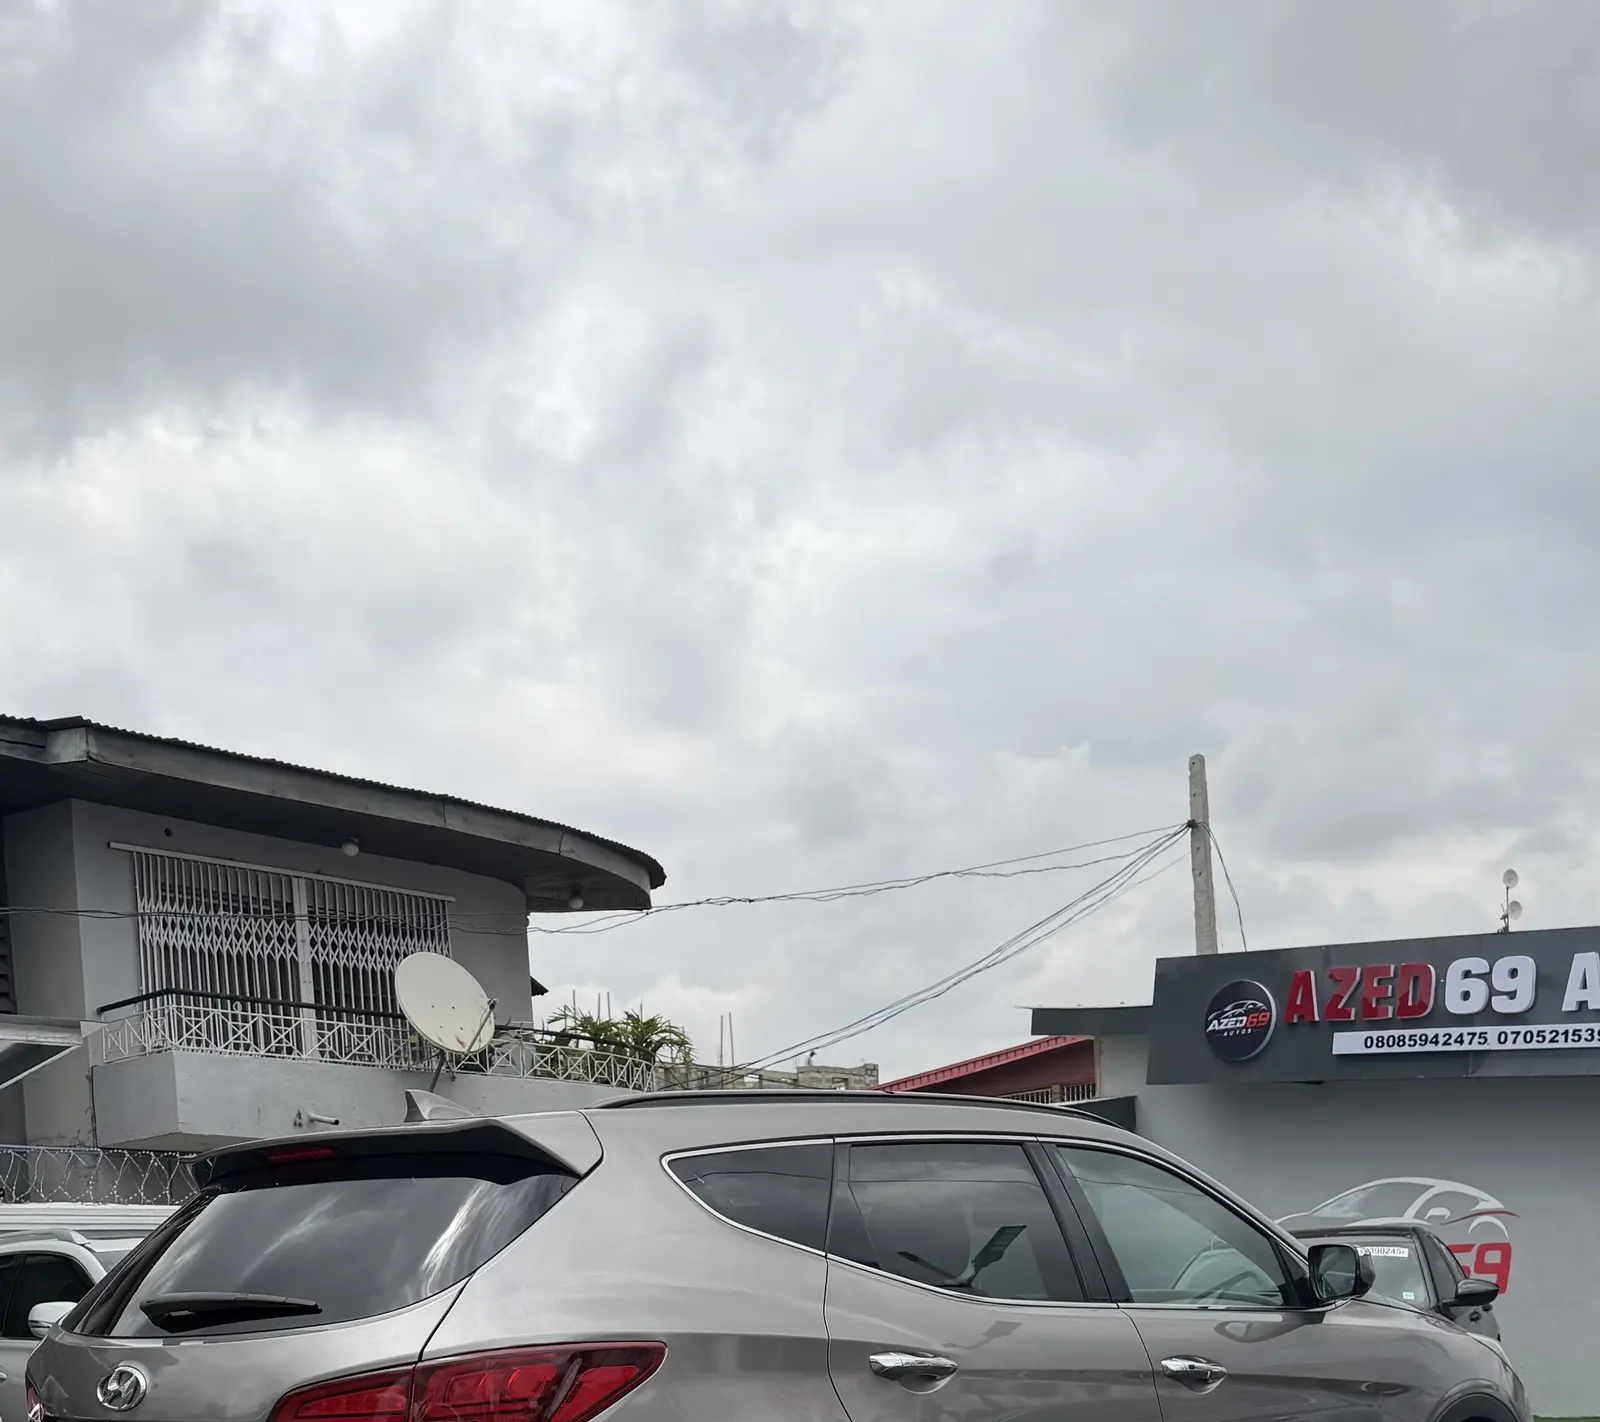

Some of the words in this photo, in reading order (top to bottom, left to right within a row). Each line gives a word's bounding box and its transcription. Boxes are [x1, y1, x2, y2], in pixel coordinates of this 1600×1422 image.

[1206, 1012, 1271, 1032] AZED69
[1223, 1028, 1252, 1037] AUTOS
[1497, 1028, 1600, 1045] 07052153
